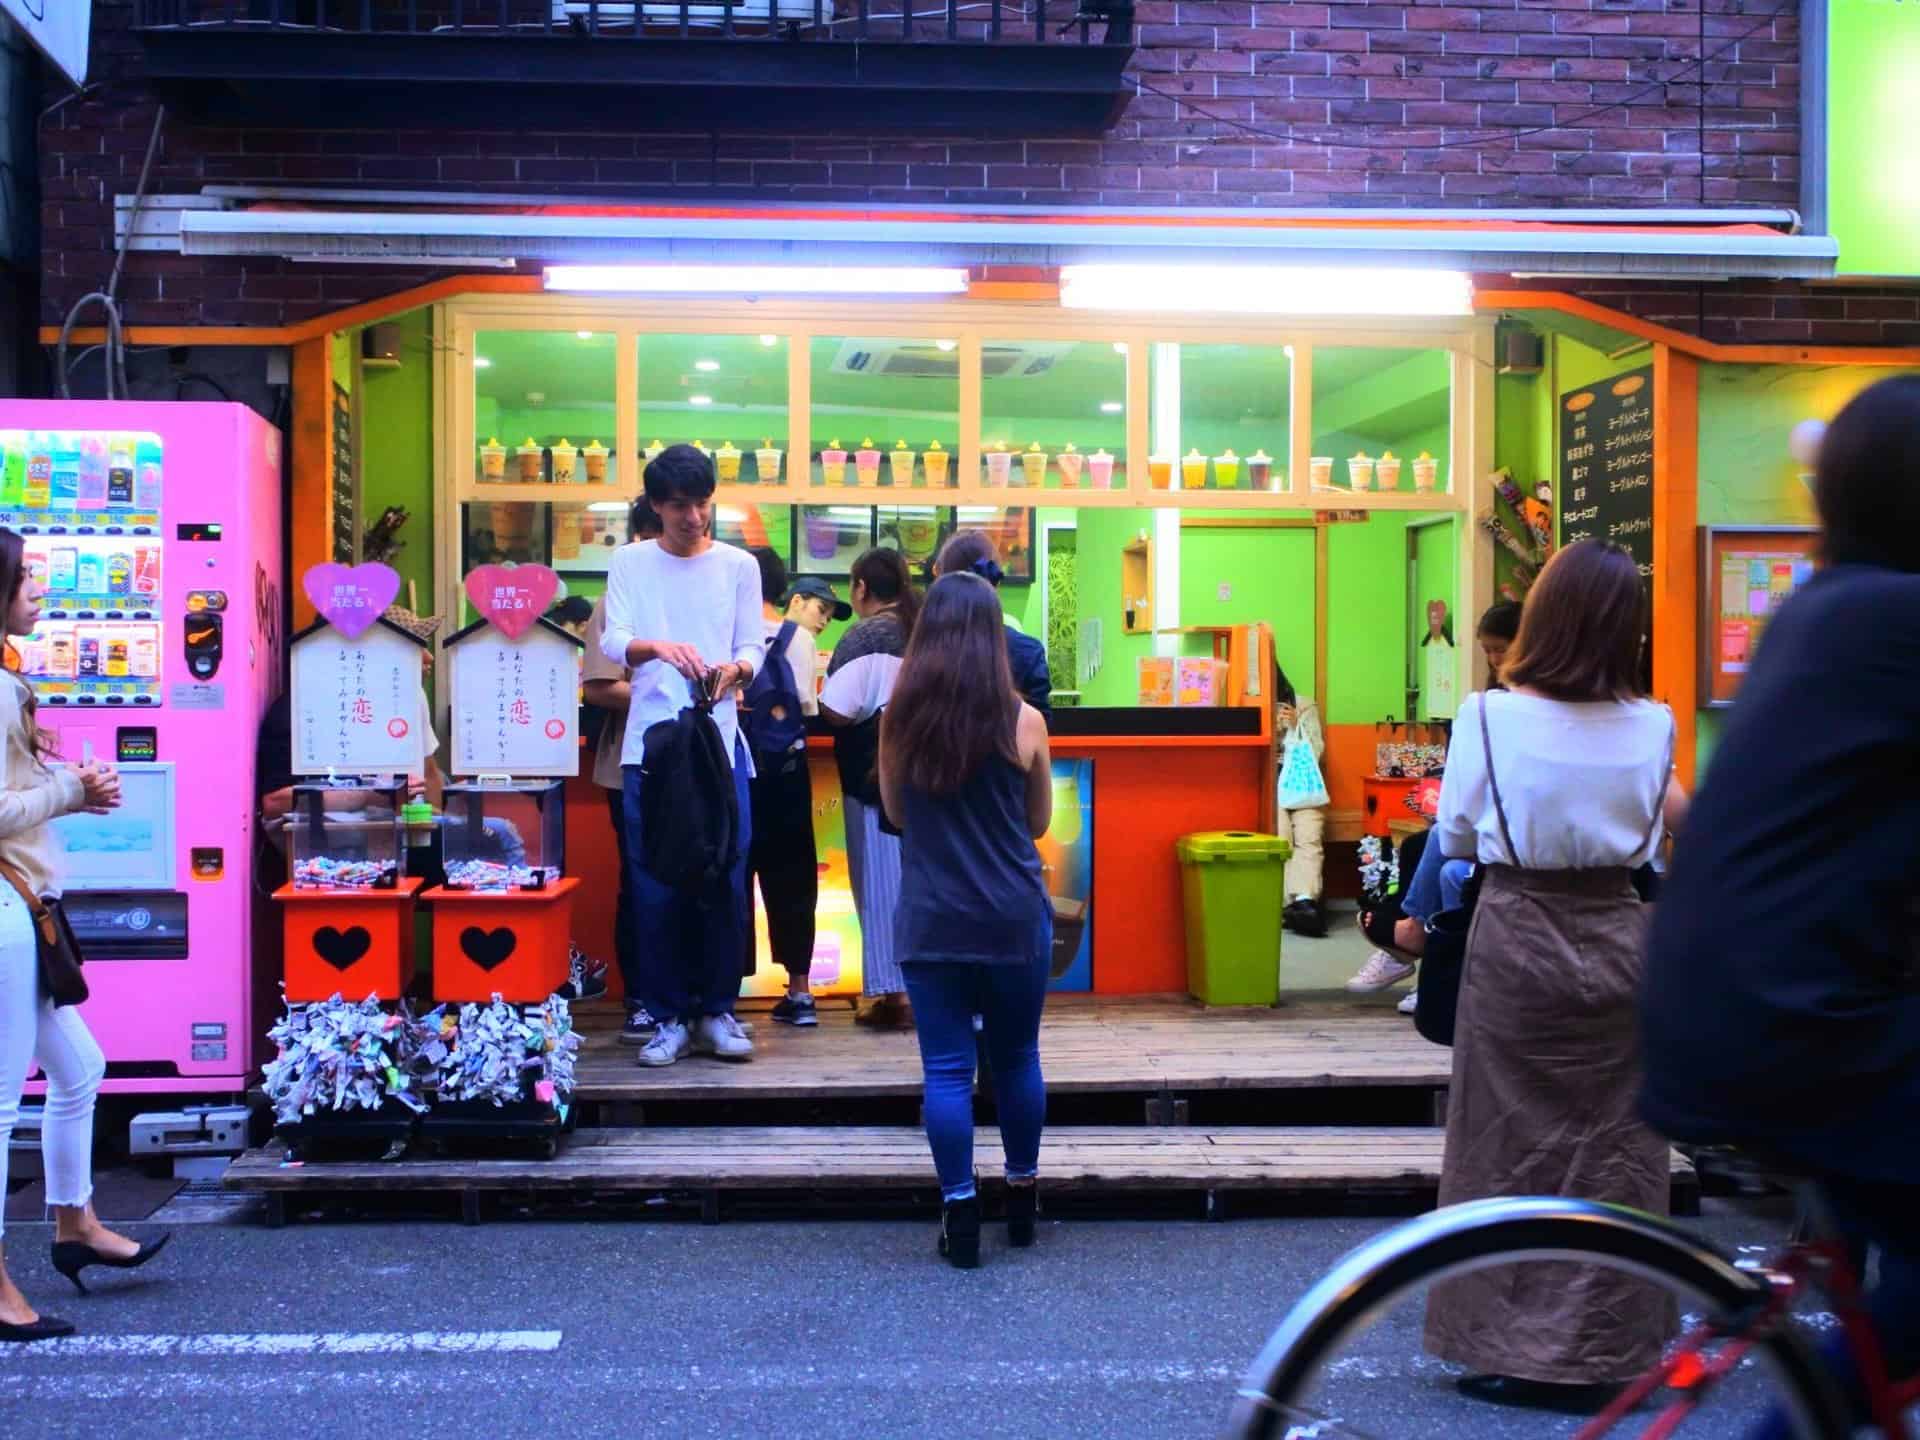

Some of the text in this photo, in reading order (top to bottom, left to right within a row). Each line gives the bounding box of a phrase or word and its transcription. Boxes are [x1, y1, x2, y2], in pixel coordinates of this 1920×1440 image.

[333, 585, 369, 598] 世界一
[495, 586, 529, 599] 世界一
[330, 597, 373, 609] 当たる！
[491, 598, 532, 610] 当たる！
[351, 650, 373, 725] あなたの恋
[510, 651, 532, 726] あなたの恋
